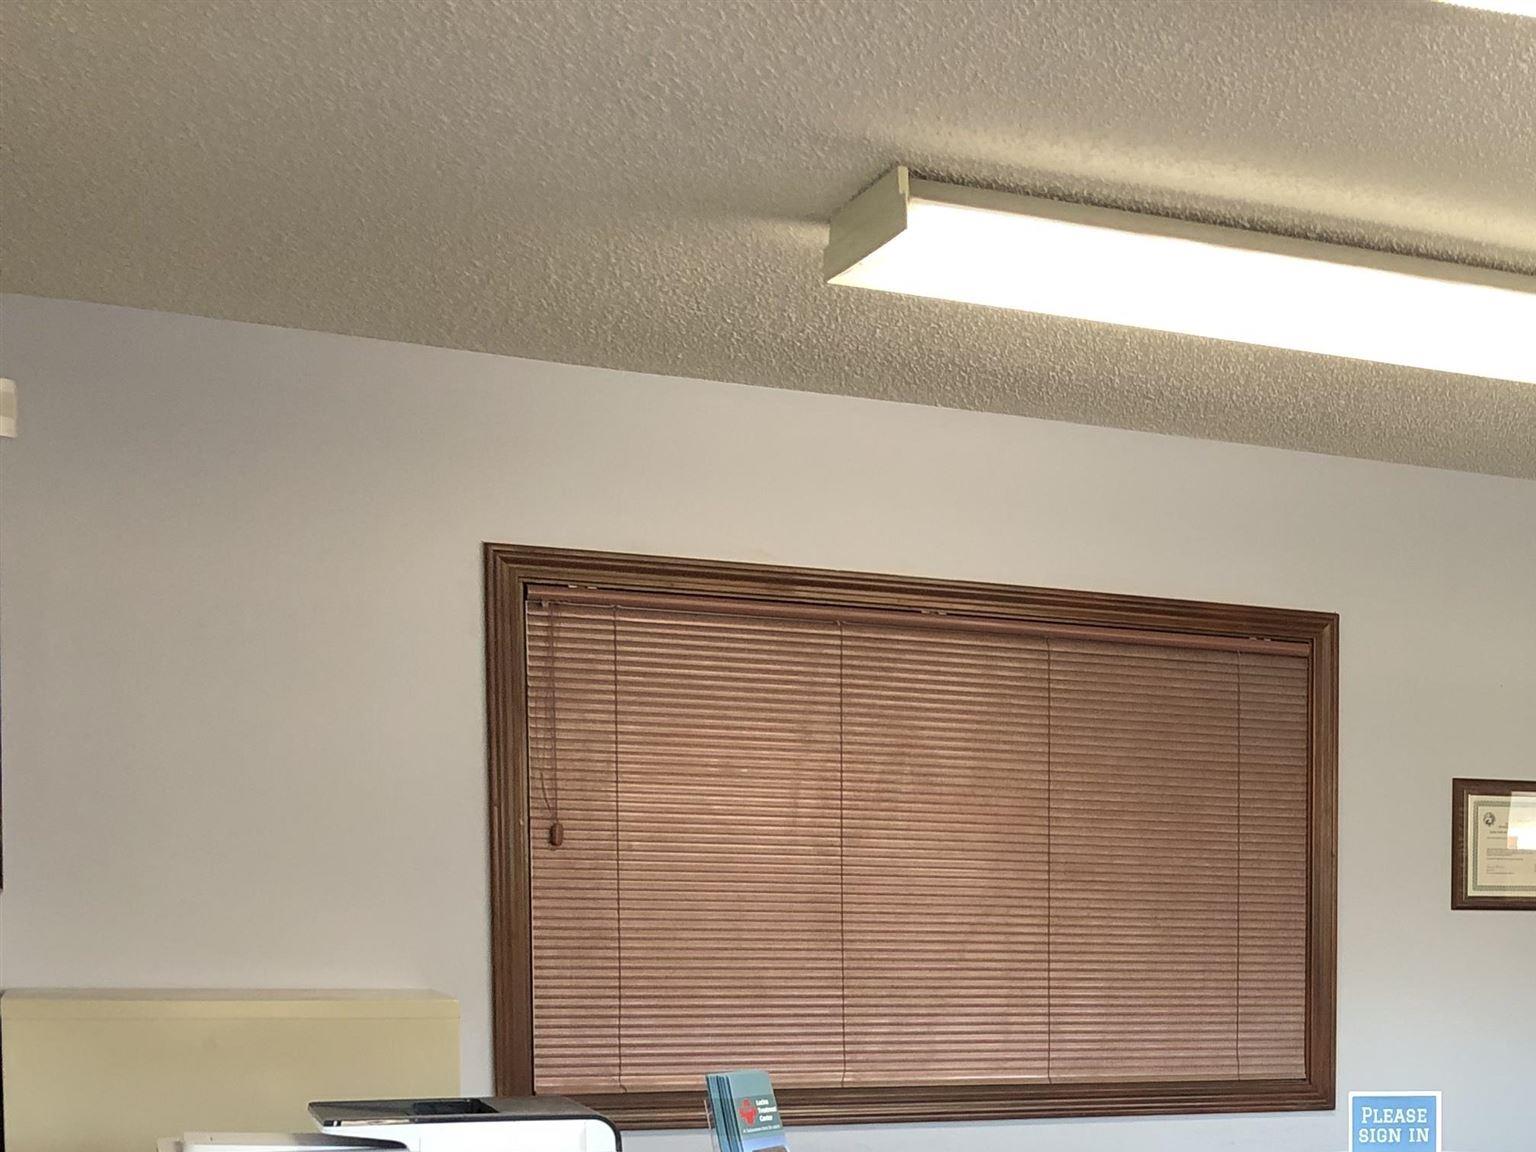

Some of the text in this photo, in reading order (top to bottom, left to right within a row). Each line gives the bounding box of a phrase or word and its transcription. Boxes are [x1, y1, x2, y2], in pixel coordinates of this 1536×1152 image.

[1361, 1106, 1427, 1124] PLEASE
[1358, 1128, 1429, 1143] SIGN IN
